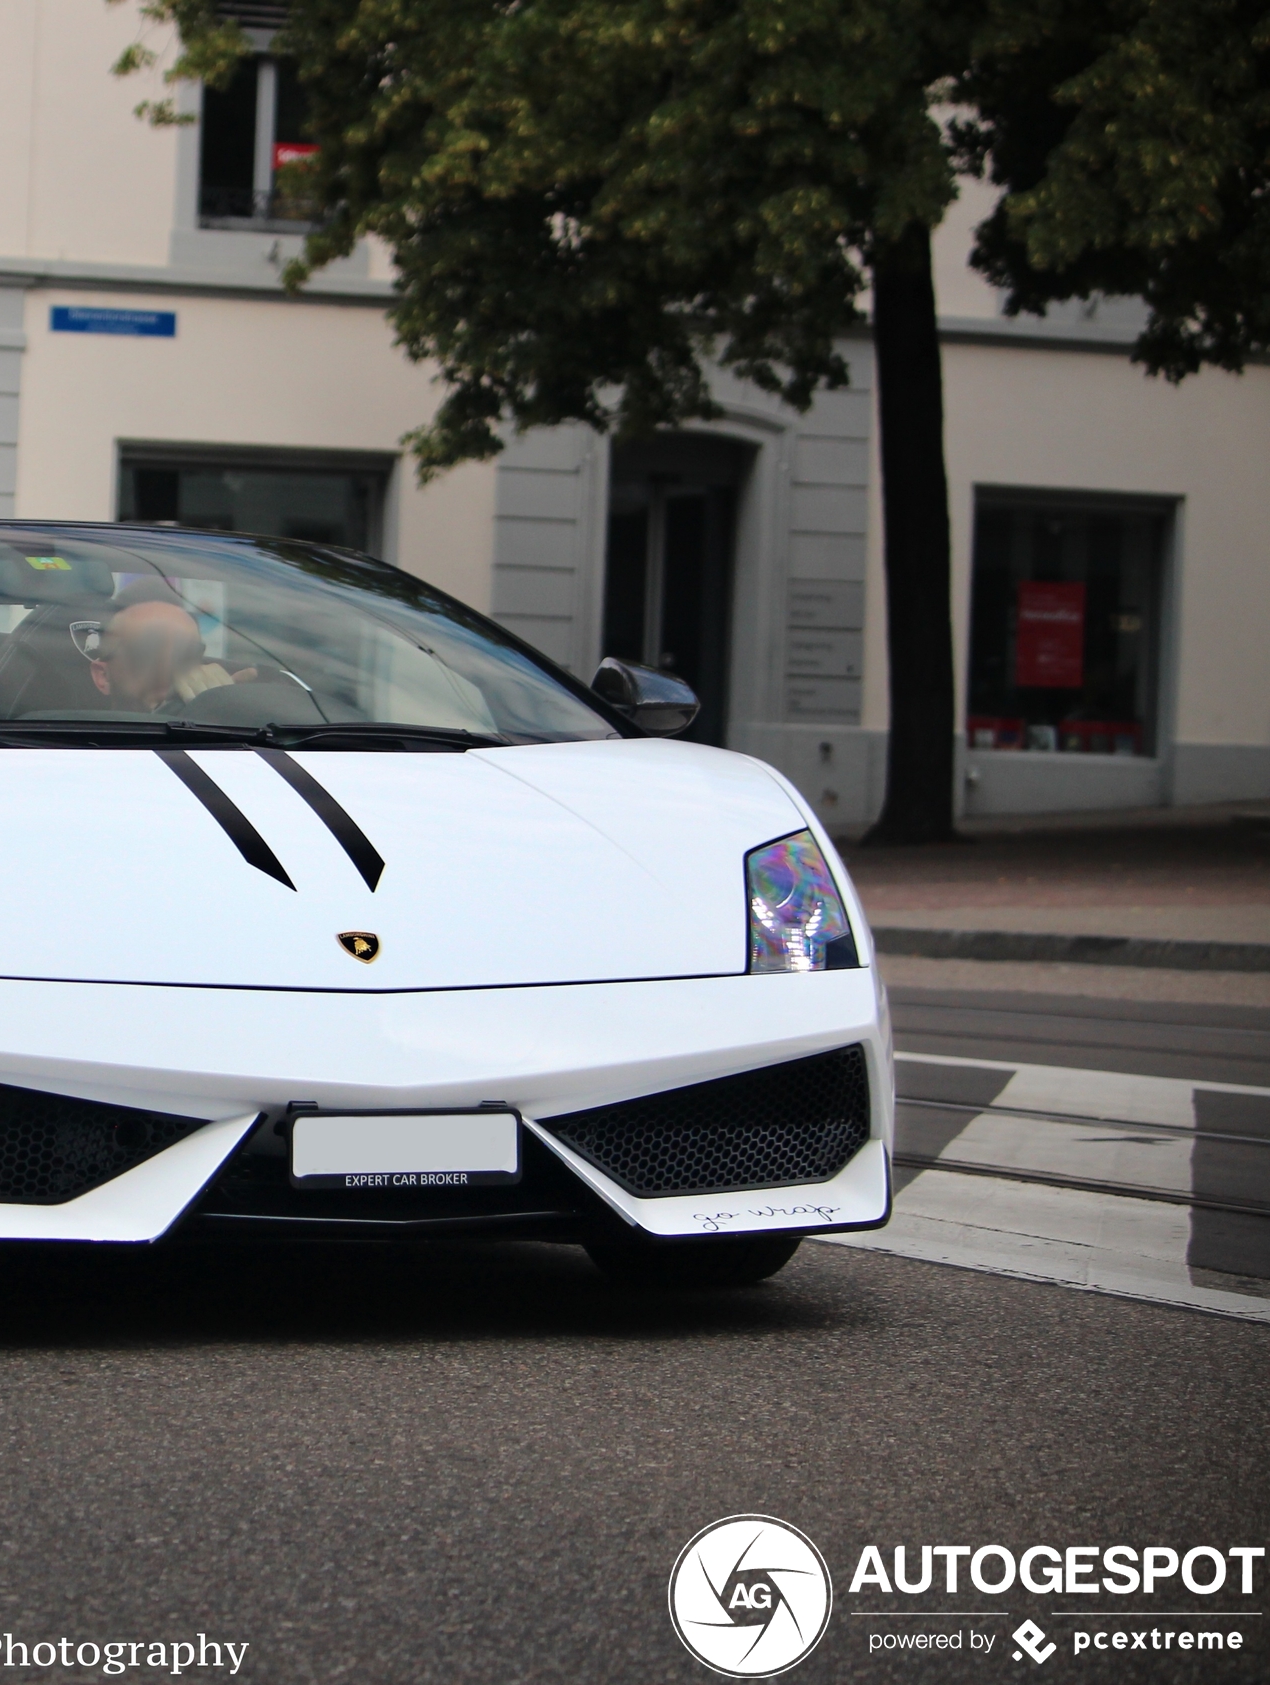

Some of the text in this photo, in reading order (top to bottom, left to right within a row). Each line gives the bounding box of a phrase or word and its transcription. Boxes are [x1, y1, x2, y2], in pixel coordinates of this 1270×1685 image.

[345, 1173, 468, 1187] EXPERT CAR BROKER
[693, 1203, 841, 1232] go wrap
